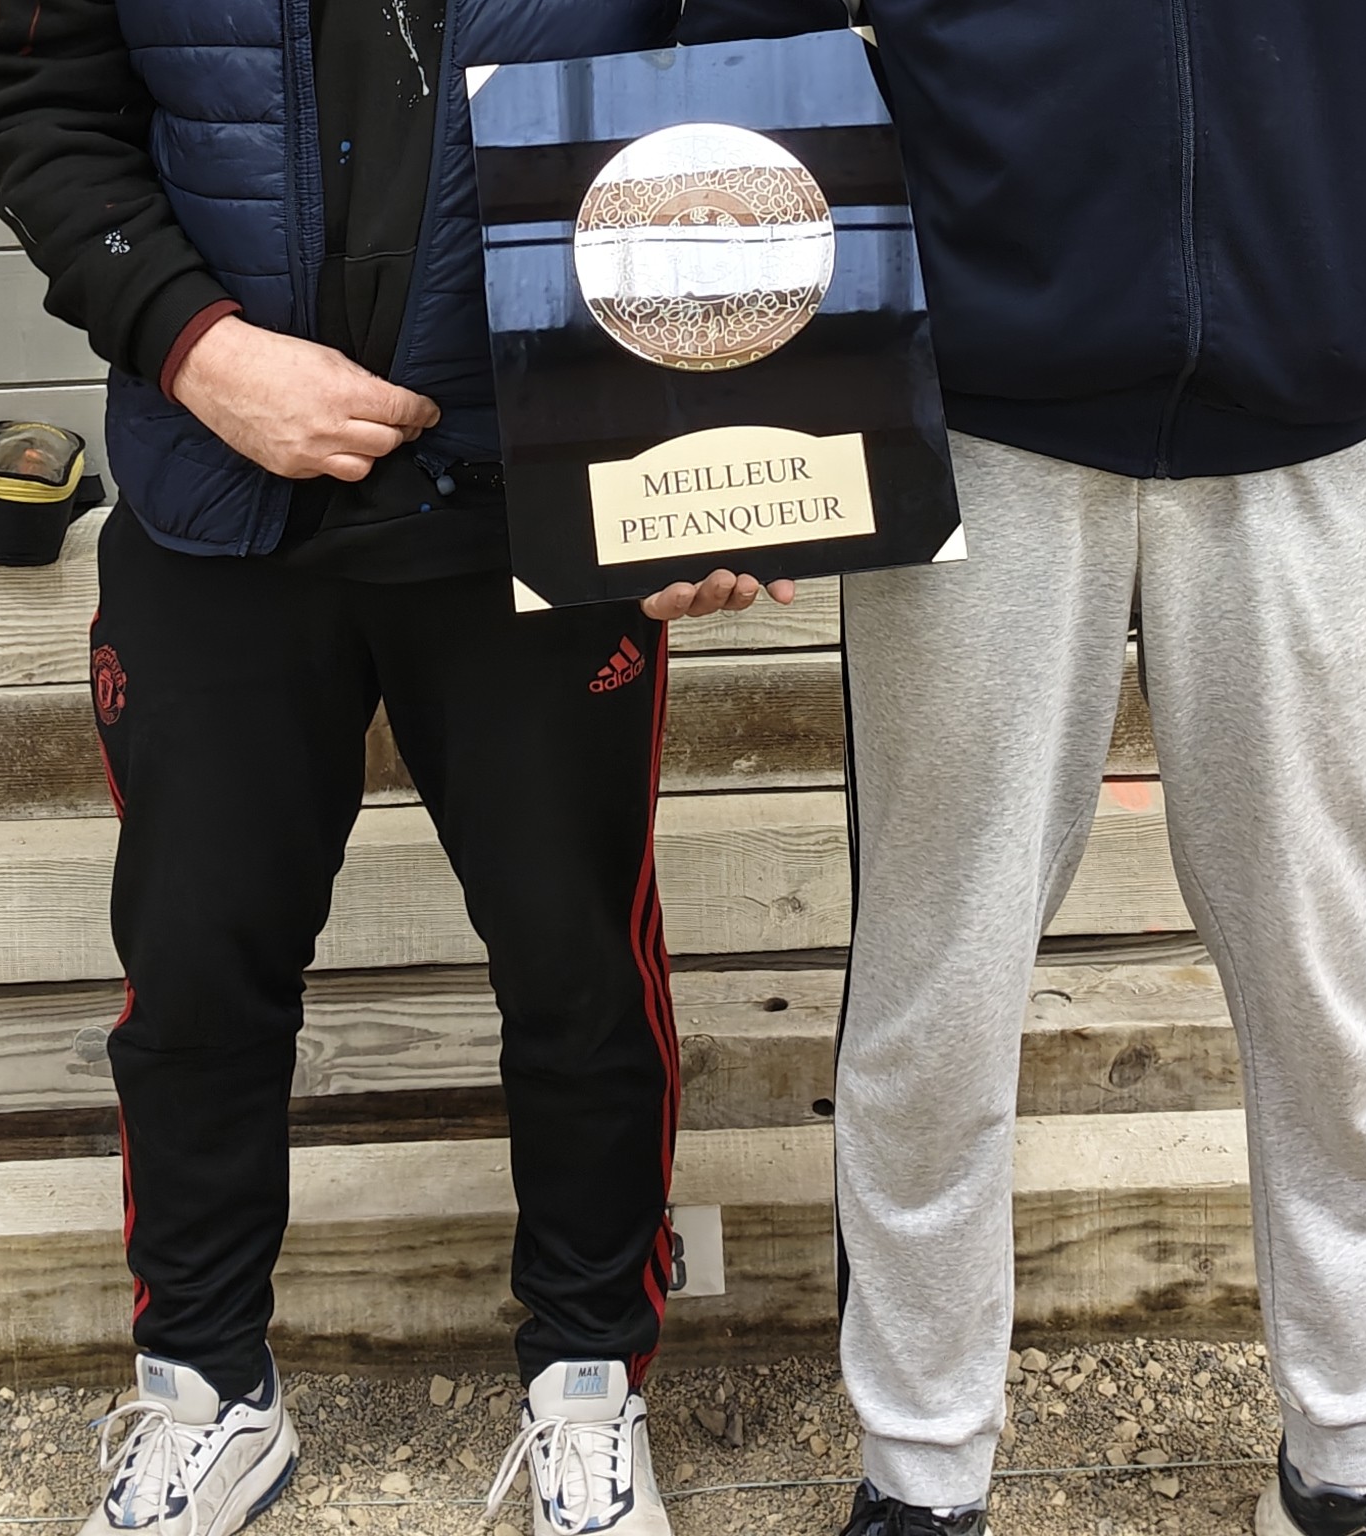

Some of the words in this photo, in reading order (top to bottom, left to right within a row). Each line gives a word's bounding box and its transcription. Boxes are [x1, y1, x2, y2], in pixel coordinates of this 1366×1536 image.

[641, 456, 813, 498] MEILLEUR
[620, 496, 846, 545] PETANQUEUR
[589, 654, 646, 693] adidas
[578, 1366, 599, 1377] MAX
